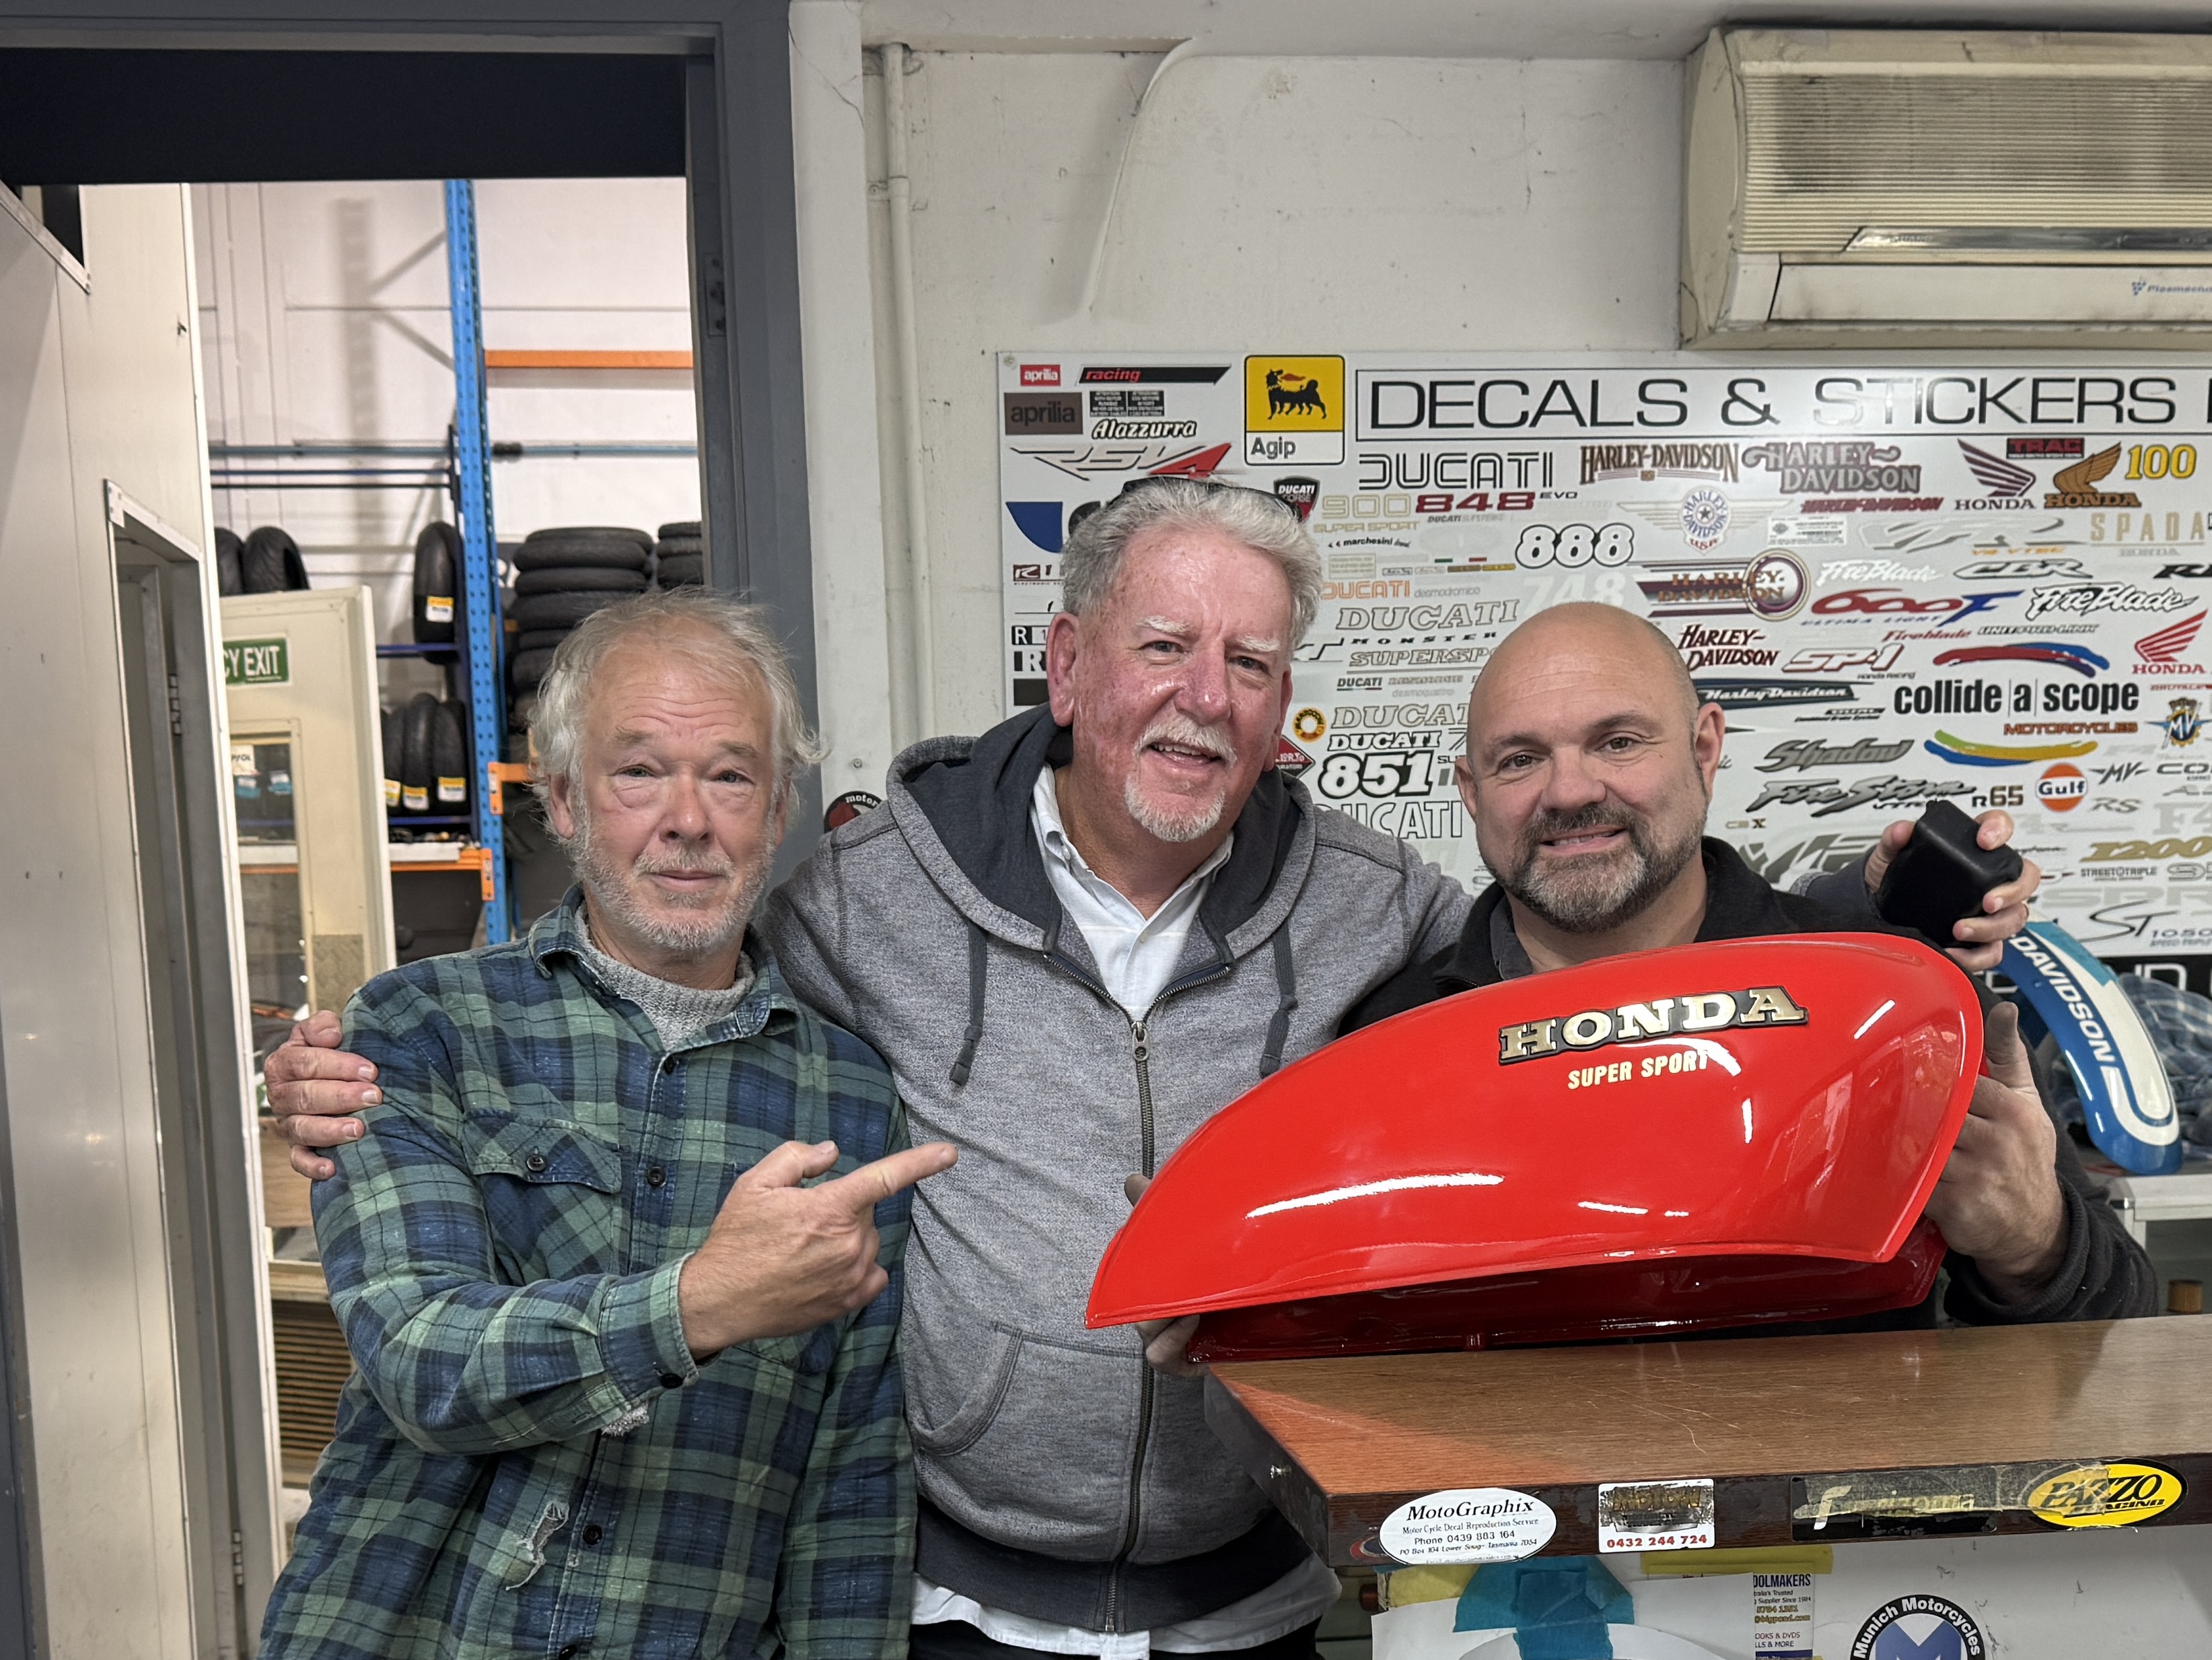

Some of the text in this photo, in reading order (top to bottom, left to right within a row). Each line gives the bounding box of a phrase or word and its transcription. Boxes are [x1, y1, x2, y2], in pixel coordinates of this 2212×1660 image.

[1024, 368, 1059, 382] aprilia
[1085, 368, 1142, 383] racing
[1010, 400, 1075, 426] aprilia
[1371, 378, 1688, 429] DECALS
[1721, 378, 1781, 426] &
[1813, 376, 2176, 425] STICKERS
[1092, 418, 1197, 440] Alazzurra
[1250, 437, 1296, 459] Agip
[1742, 442, 1902, 471] HARLEY
[2008, 438, 2083, 454] TRAC
[1359, 452, 1554, 490] DUCATI
[1579, 442, 1740, 485] HARLEY-DAVIDSON
[2125, 443, 2197, 480] 100
[1278, 485, 1315, 495] DUCATI
[1779, 464, 1922, 494] DAVIDSON
[1322, 494, 1413, 520] 900
[1415, 492, 1536, 514] 848
[1954, 498, 2036, 510] HONDA
[2044, 492, 2142, 509] HONDA
[1427, 514, 1462, 524] DUCATI
[2090, 511, 2205, 542] SPADA
[1343, 537, 1393, 547] marchesini
[1514, 522, 1635, 569] 888
[1672, 569, 1785, 586] HARLEY
[1320, 580, 1411, 600] DUCATI
[1657, 586, 1785, 602] DAVIDSON
[2024, 581, 2199, 622] FireBlade
[1335, 598, 1520, 631] DUCATI
[1350, 631, 1497, 645] MONSTER
[244, 645, 281, 677] EXIT
[1349, 647, 1500, 667] SUPERSP
[1685, 648, 1781, 672] DAVIDSON
[2132, 664, 2205, 675] HONDA
[1336, 677, 1383, 687] DUCATI
[1893, 679, 2002, 715] collide
[2042, 681, 2139, 715] scope
[2003, 722, 2139, 736] MOTORCYCLES
[1327, 730, 1443, 752] DUCATI
[1753, 737, 1915, 773] Shadow
[1317, 749, 1435, 800] 851
[2038, 781, 2085, 796] Gulf
[2009, 934, 2116, 1063] DAVIDSON
[1499, 985, 1808, 1066] HONDA
[1567, 1049, 1709, 1091] SUPER SPORT
[1406, 1498, 1534, 1521] MotoGraphix
[1414, 1536, 1443, 1546] Phone
[1447, 1534, 1472, 1543] 0439
[1499, 1530, 1515, 1539] 164
[1423, 1524, 1442, 1534] Cycle
[1443, 1522, 1464, 1531] Decal
[1606, 1534, 1707, 1548] 0432 244 724
[1853, 1597, 1981, 1659] Munich Motorcycles
